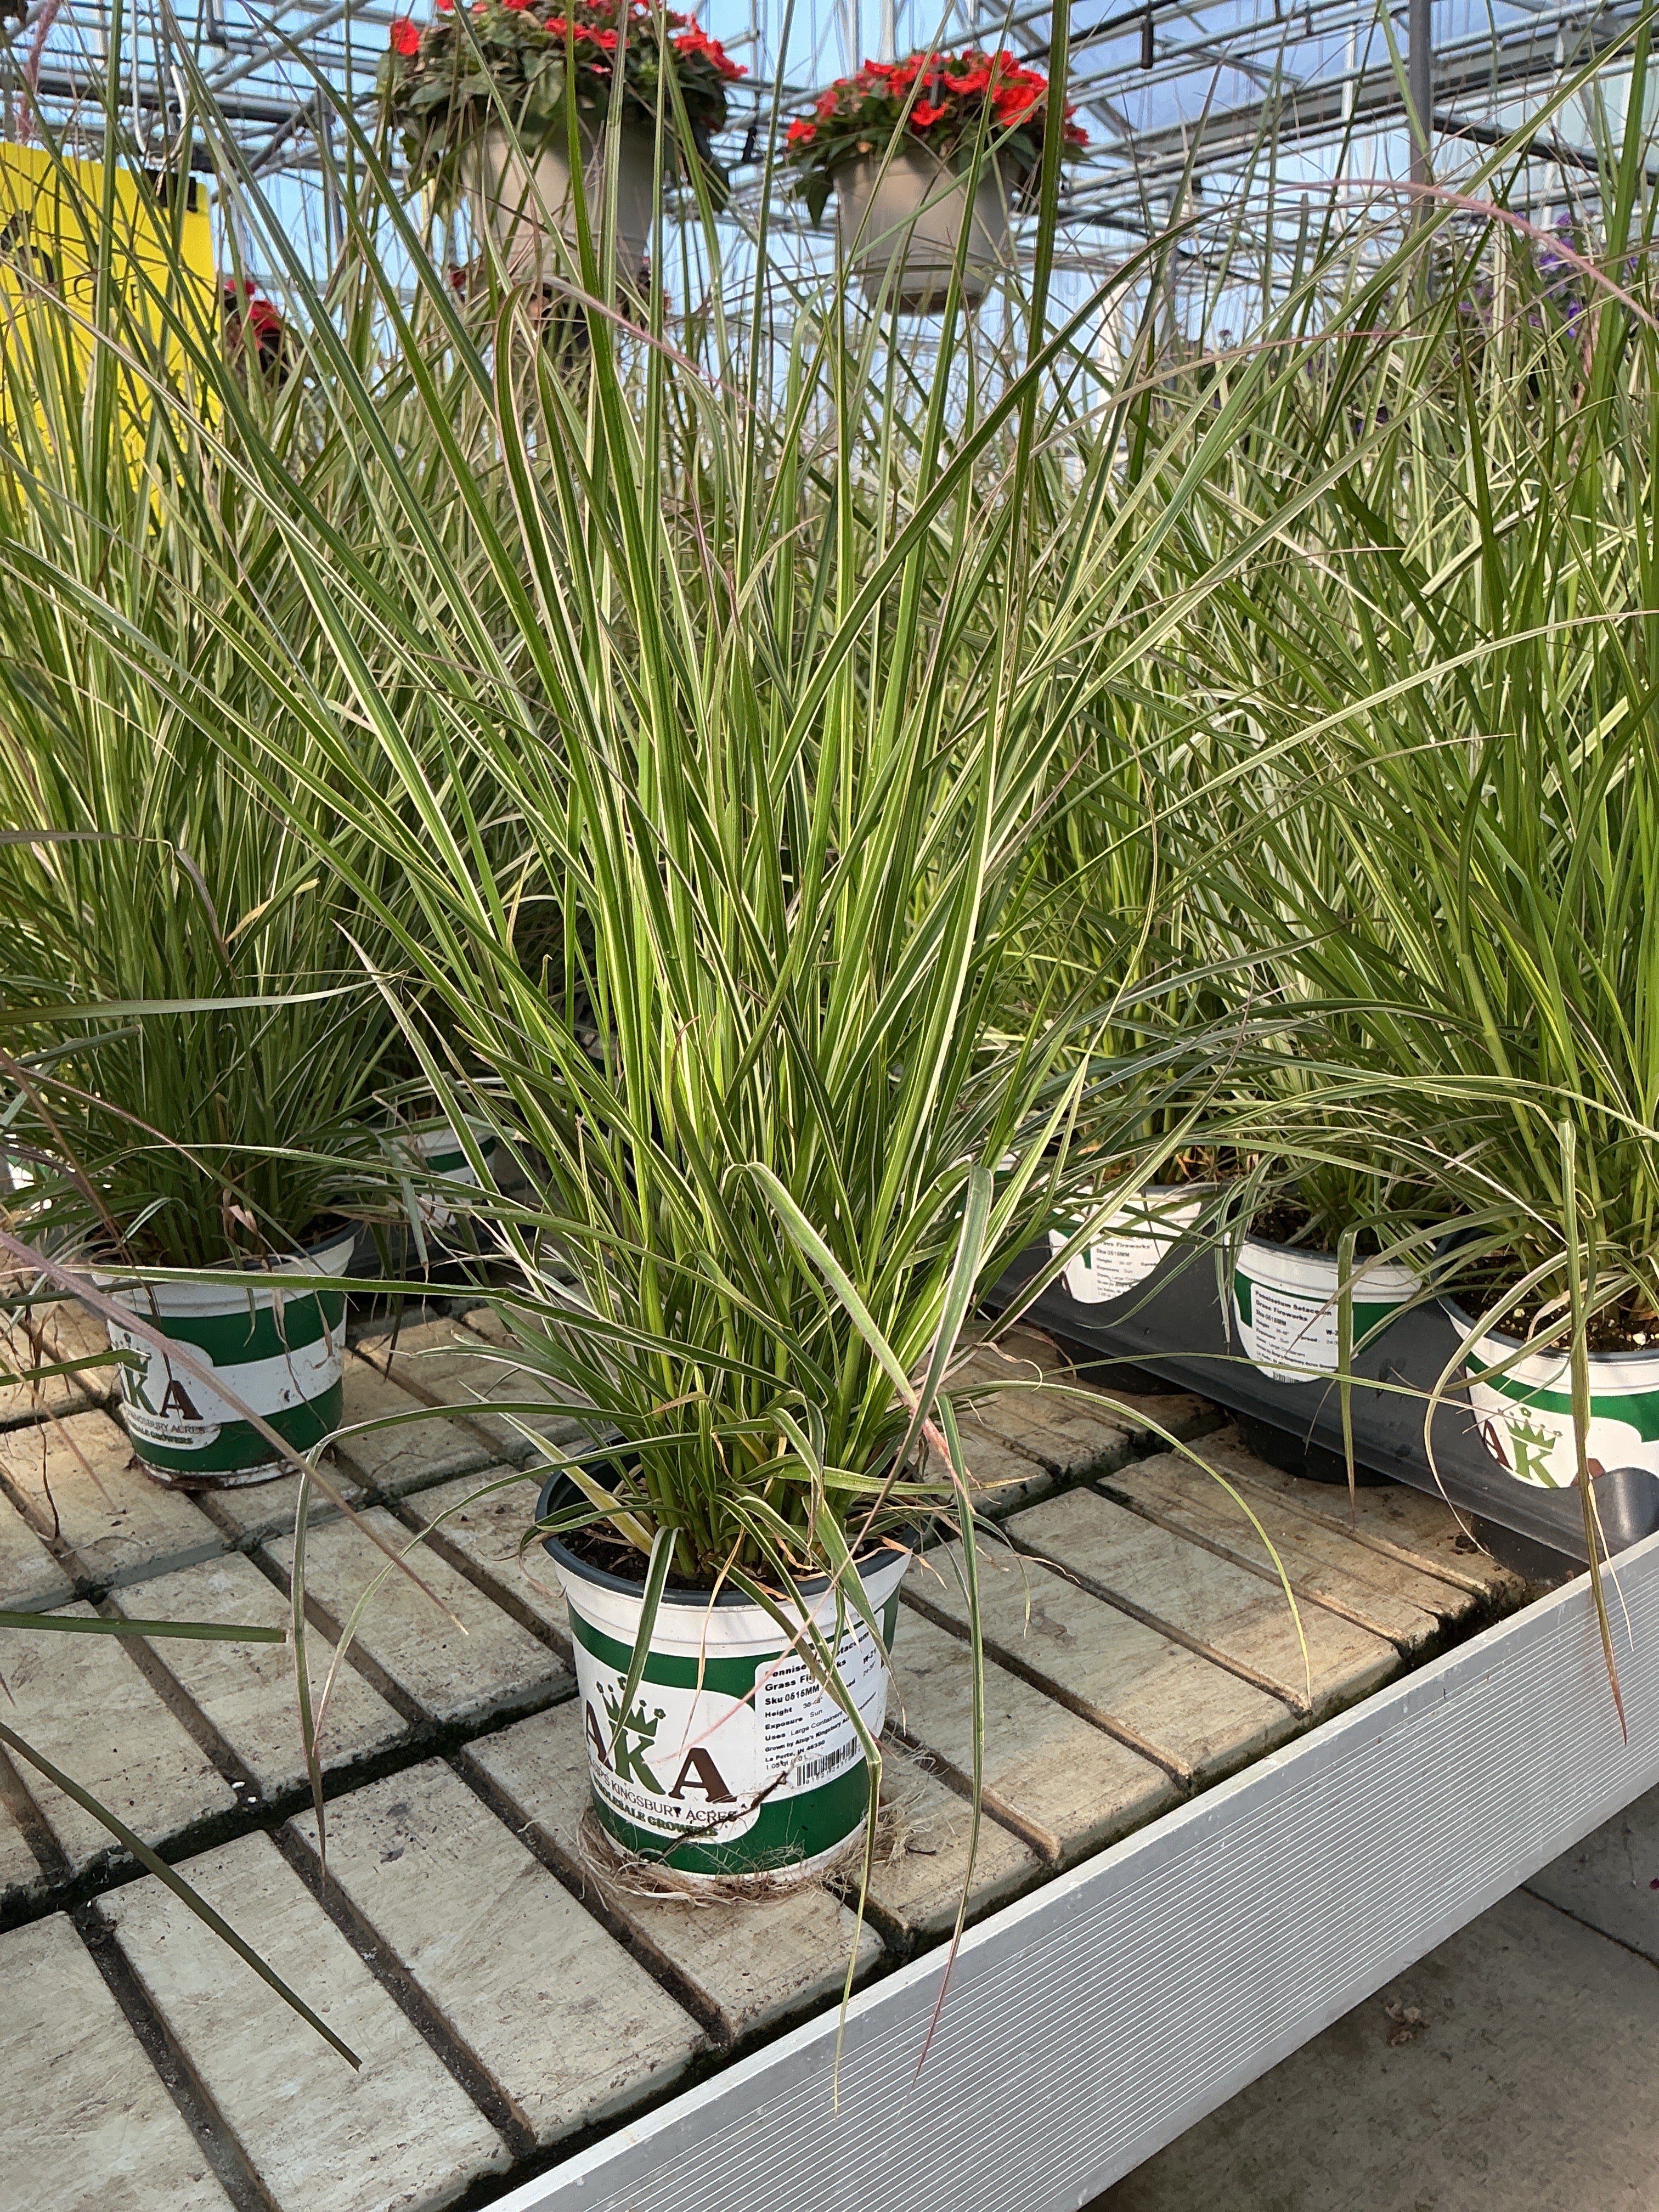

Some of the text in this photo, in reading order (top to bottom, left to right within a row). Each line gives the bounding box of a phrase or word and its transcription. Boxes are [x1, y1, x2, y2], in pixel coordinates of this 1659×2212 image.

[765, 1679, 797, 1691] Grass
[765, 1697, 783, 1706] Sku
[765, 1707, 793, 1718] Height
[765, 1709, 823, 1730] Exposure Sun
[765, 1733, 786, 1741] Uses
[790, 1725, 810, 1736] Large
[811, 1711, 843, 1729] Containers
[765, 1744, 786, 1752] Grown
[611, 1779, 682, 1818] KINGSBURY
